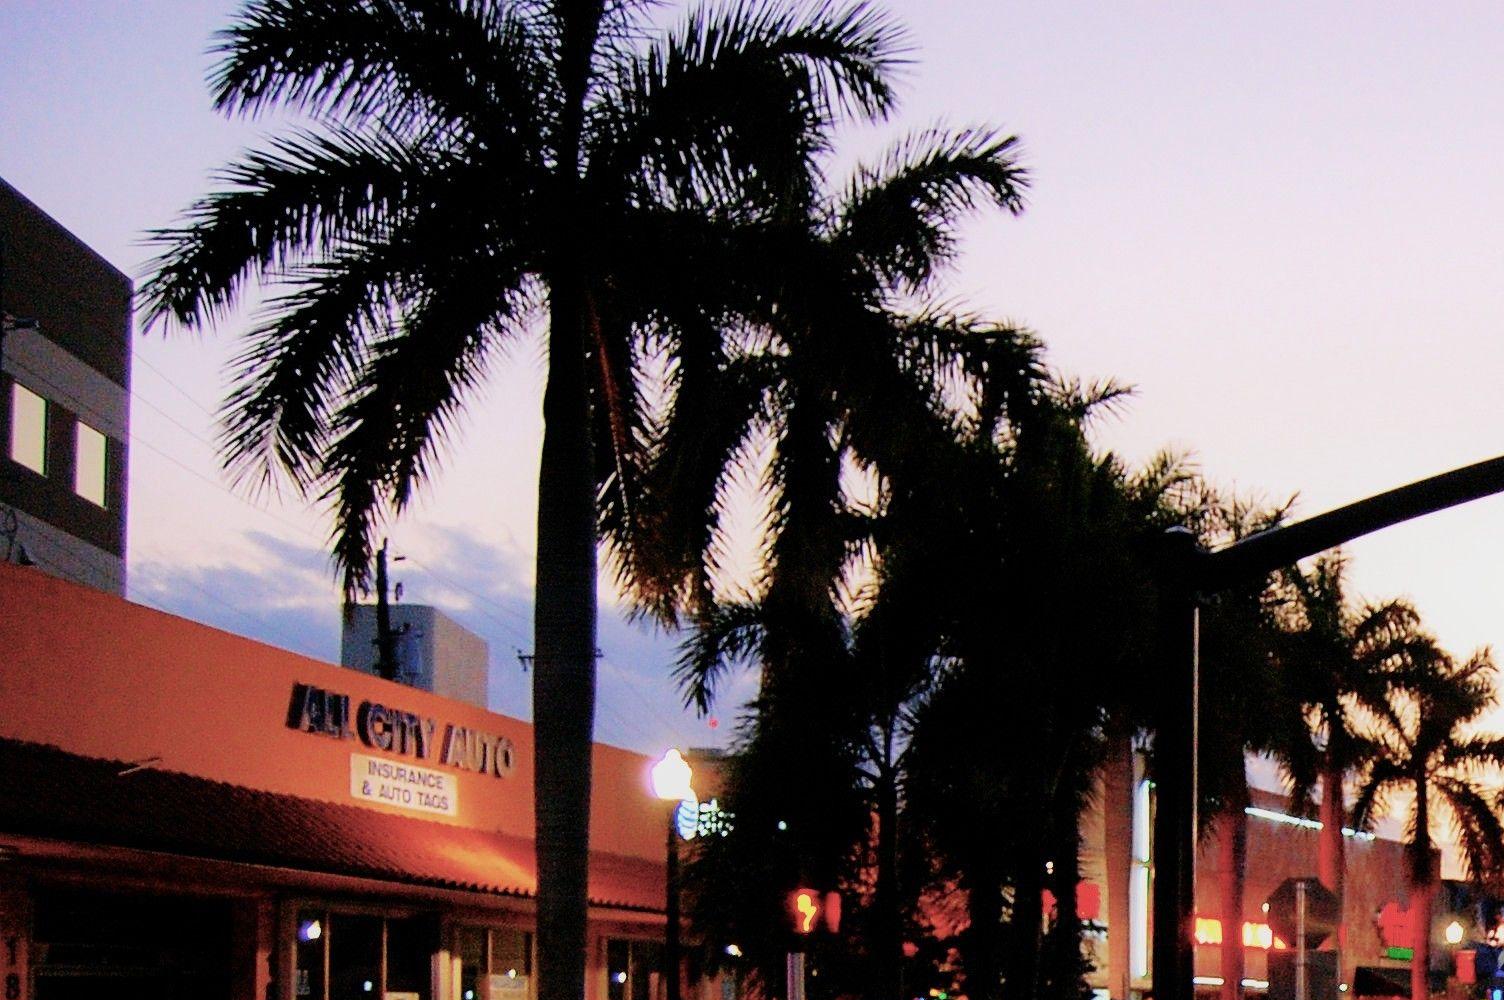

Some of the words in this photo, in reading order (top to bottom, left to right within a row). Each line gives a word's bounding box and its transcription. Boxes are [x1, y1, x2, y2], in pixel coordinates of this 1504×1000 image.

[286, 682, 354, 741] ALL
[357, 700, 436, 759] CITY
[439, 723, 517, 778] AUTO
[368, 760, 444, 790] INSURANCE
[361, 780, 372, 796] &
[379, 784, 411, 805] AUTO
[417, 792, 449, 811] TAGS
